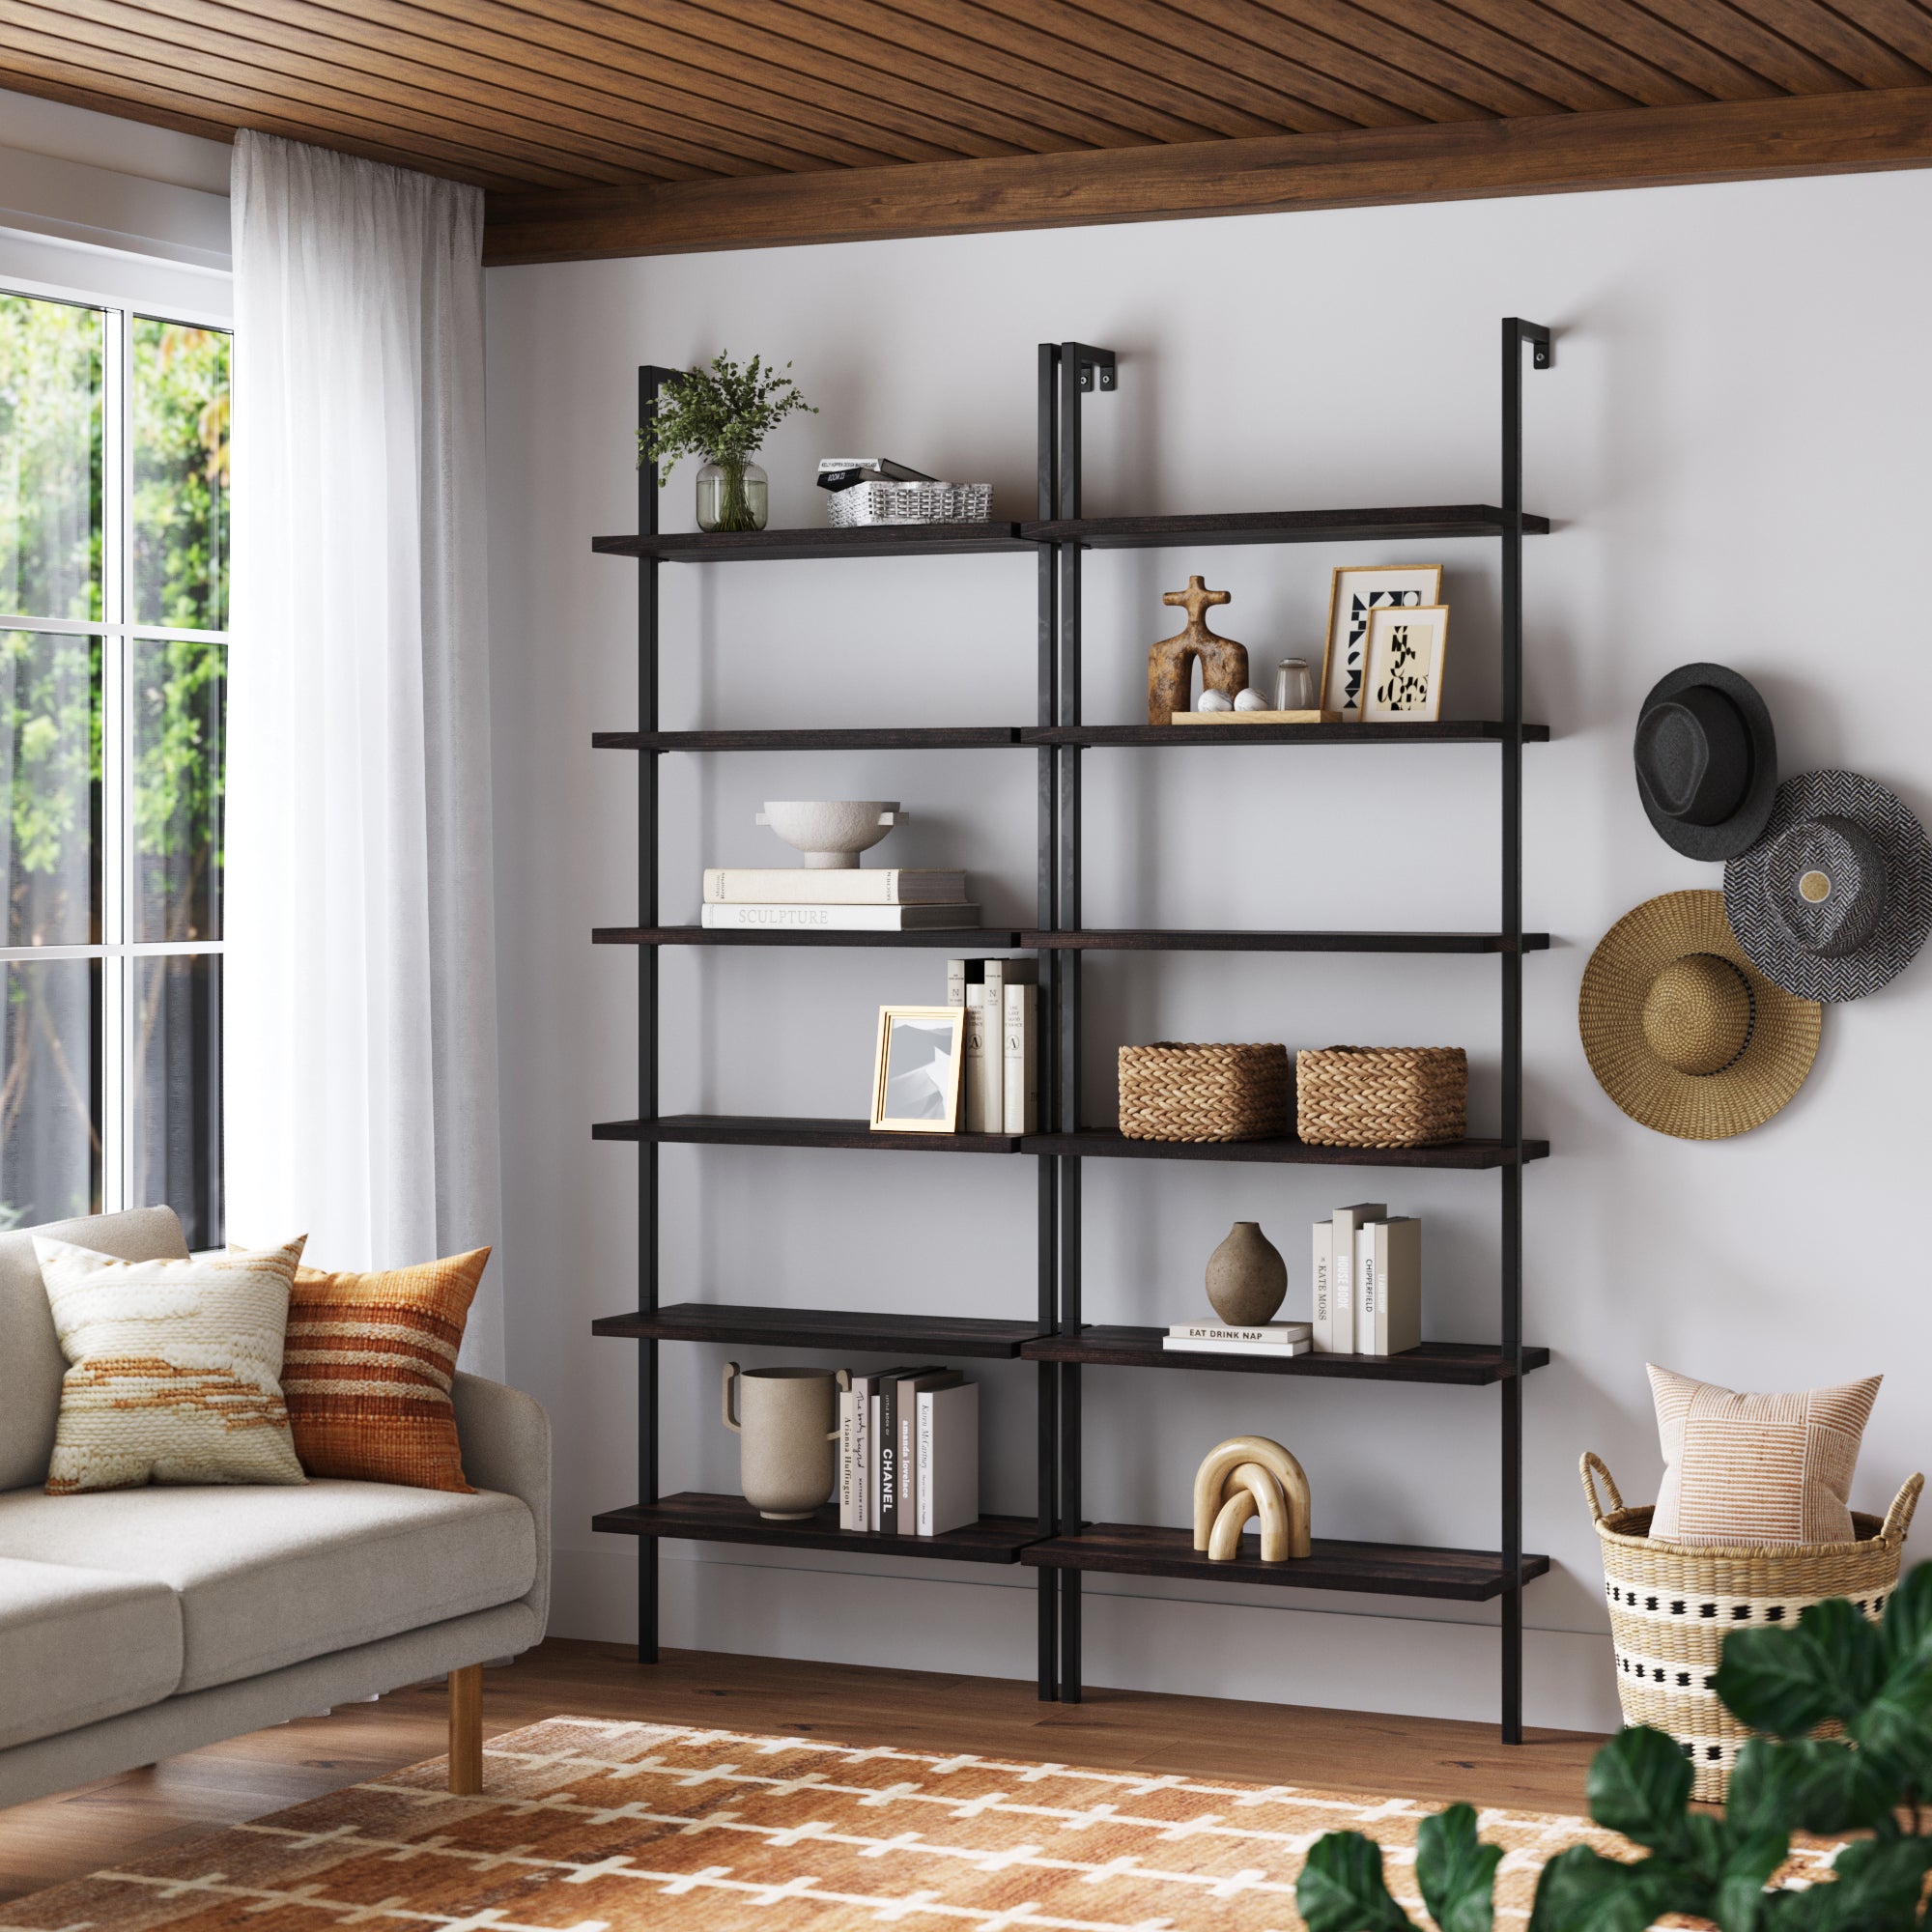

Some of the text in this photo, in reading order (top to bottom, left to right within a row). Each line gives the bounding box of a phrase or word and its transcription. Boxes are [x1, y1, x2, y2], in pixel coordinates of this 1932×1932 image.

[738, 909, 828, 924] SCULPTURE
[1318, 1264, 1326, 1292] KATE
[1337, 1256, 1350, 1309] HOUSE BOOK
[1318, 1293, 1326, 1321] MOSS
[1189, 1328, 1207, 1337] EAT
[1209, 1330, 1239, 1339] DRINK
[852, 1391, 867, 1468] The body beyond
[920, 1428, 929, 1468] McCartney
[842, 1456, 852, 1506] Huffington
[882, 1448, 894, 1513] CHANEL
